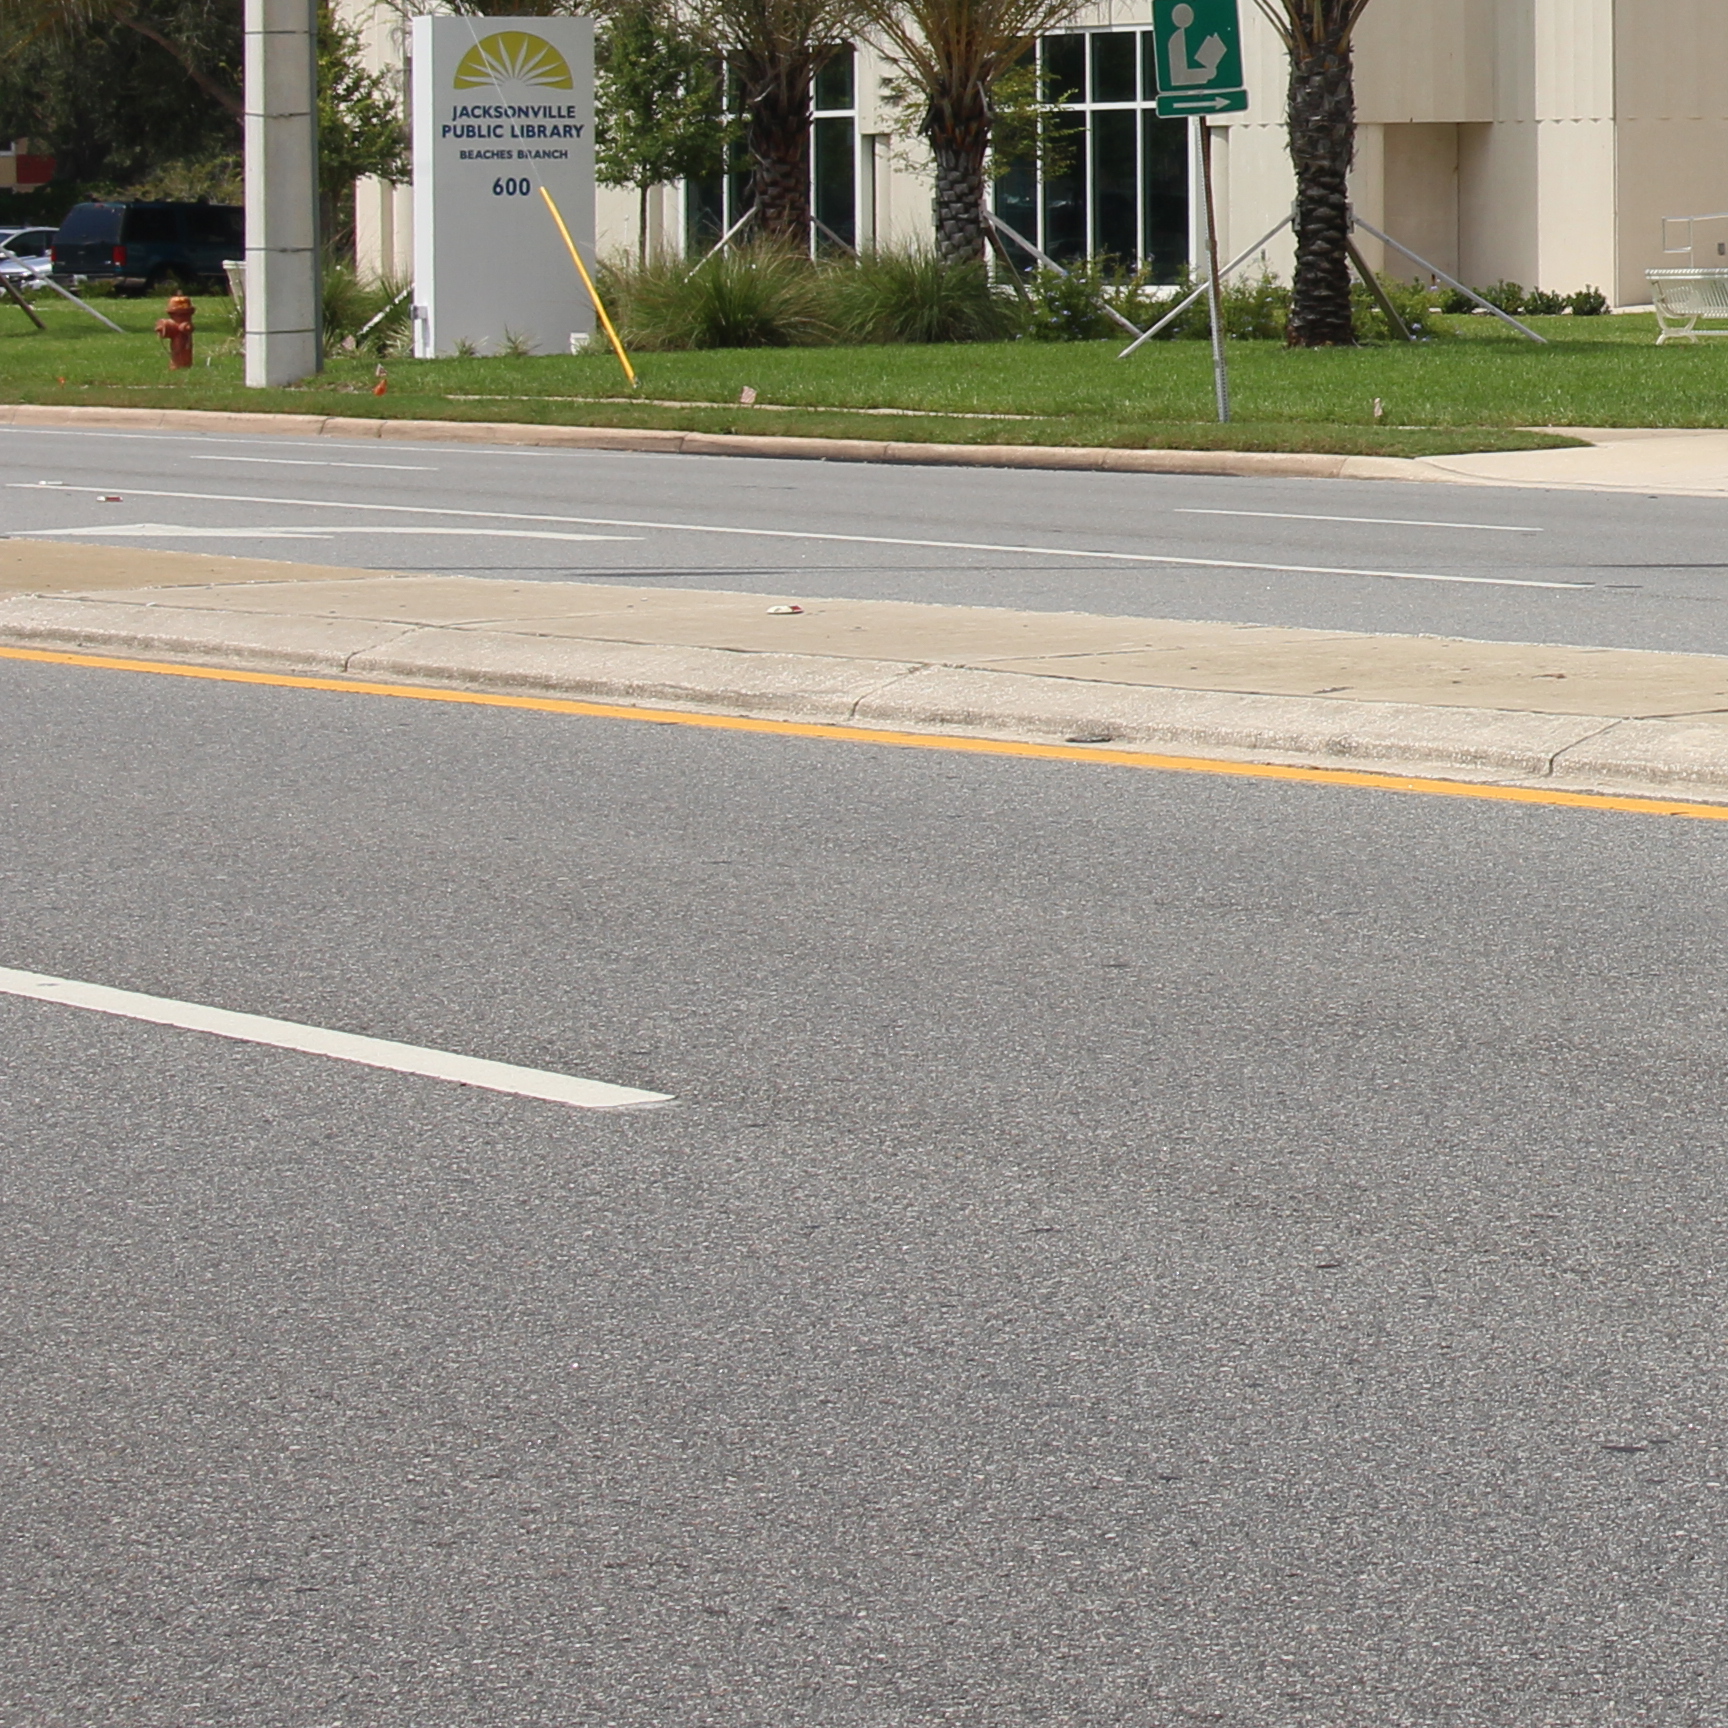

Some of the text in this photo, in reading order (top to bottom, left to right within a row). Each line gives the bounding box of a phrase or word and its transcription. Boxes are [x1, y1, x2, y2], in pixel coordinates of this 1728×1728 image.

[452, 106, 576, 121] JACKSONVILLE
[442, 124, 584, 138] PUBLIC LIBRARY
[460, 150, 568, 159] BEACHES BRANCH
[492, 177, 531, 196] 600
